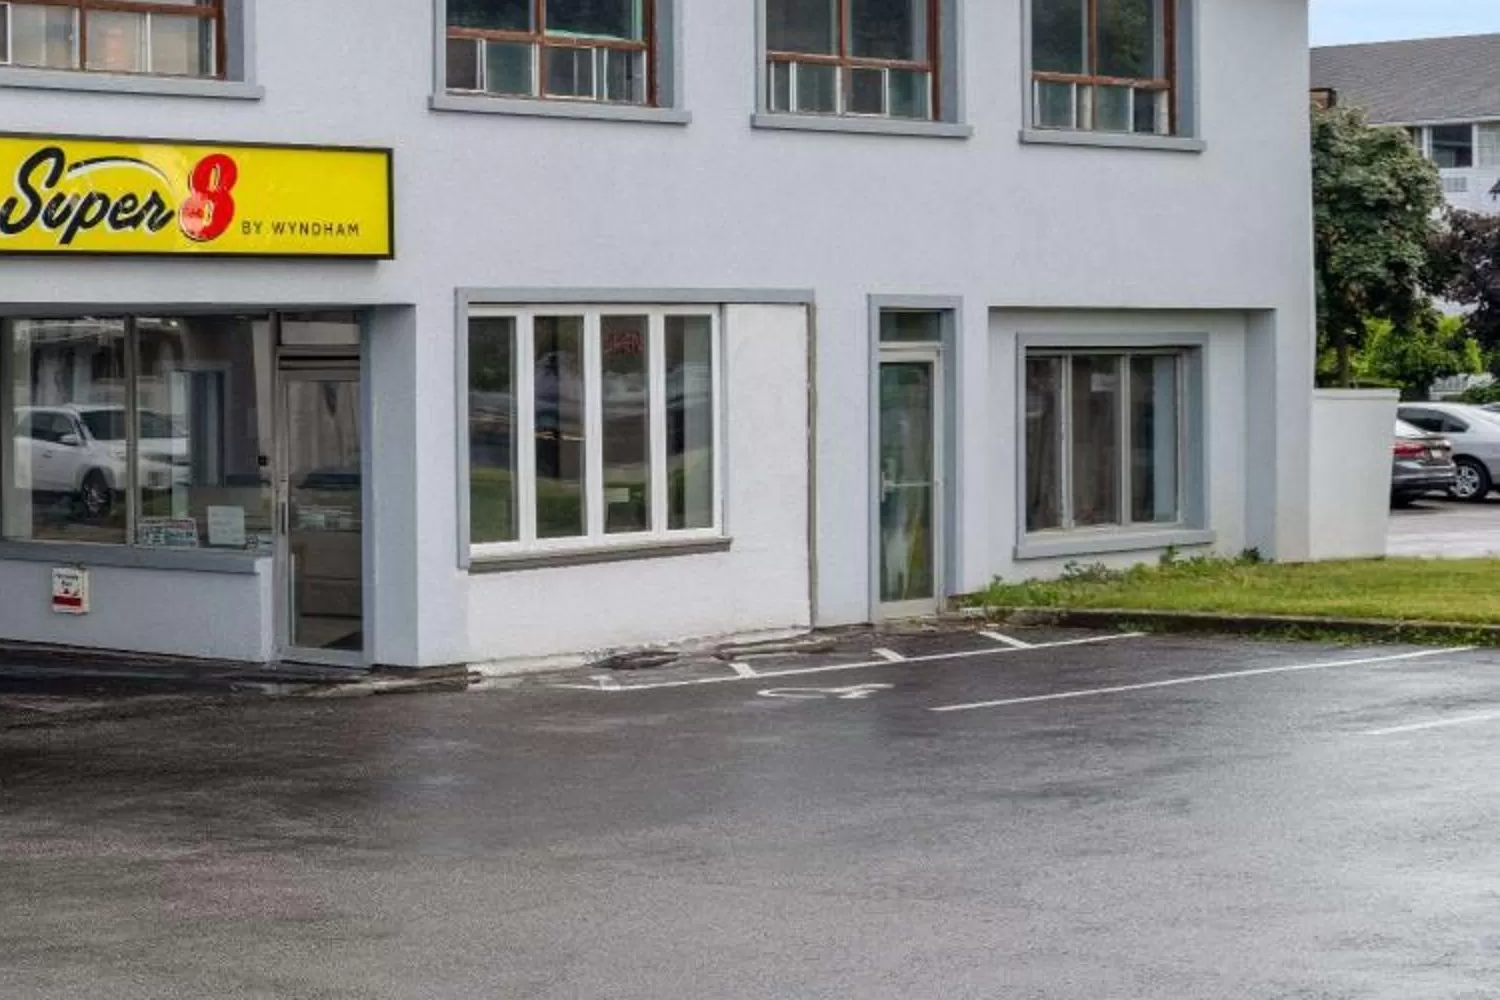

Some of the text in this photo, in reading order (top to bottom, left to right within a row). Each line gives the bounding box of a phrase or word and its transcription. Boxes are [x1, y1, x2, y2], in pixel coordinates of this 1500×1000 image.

[179, 152, 238, 241] 8
[241, 219, 360, 237] BY WYNDHAM
